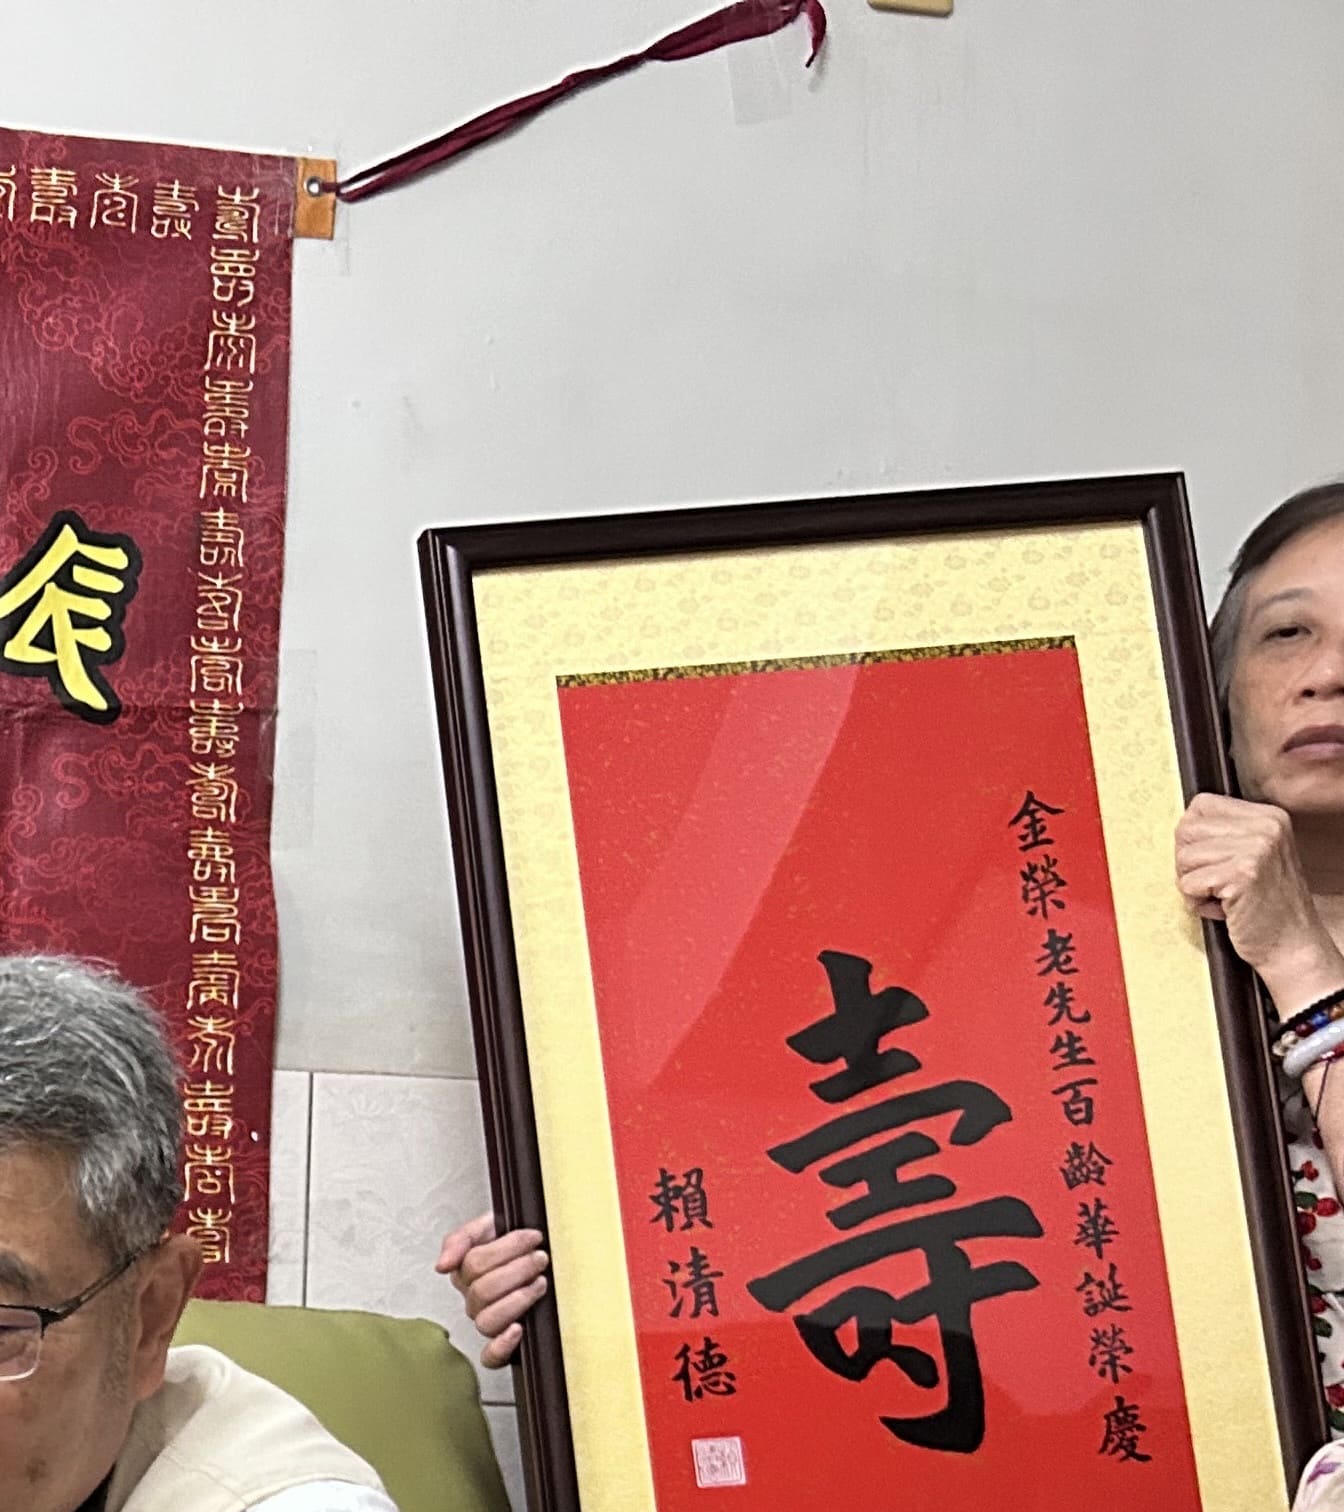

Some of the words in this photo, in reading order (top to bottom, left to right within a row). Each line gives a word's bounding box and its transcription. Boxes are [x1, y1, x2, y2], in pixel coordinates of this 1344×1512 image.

[648, 1167, 738, 1403] 賴清德
[746, 950, 1044, 1454] 壽
[1008, 789, 1153, 1463] 金榮老先生百齡華誕榮慶
